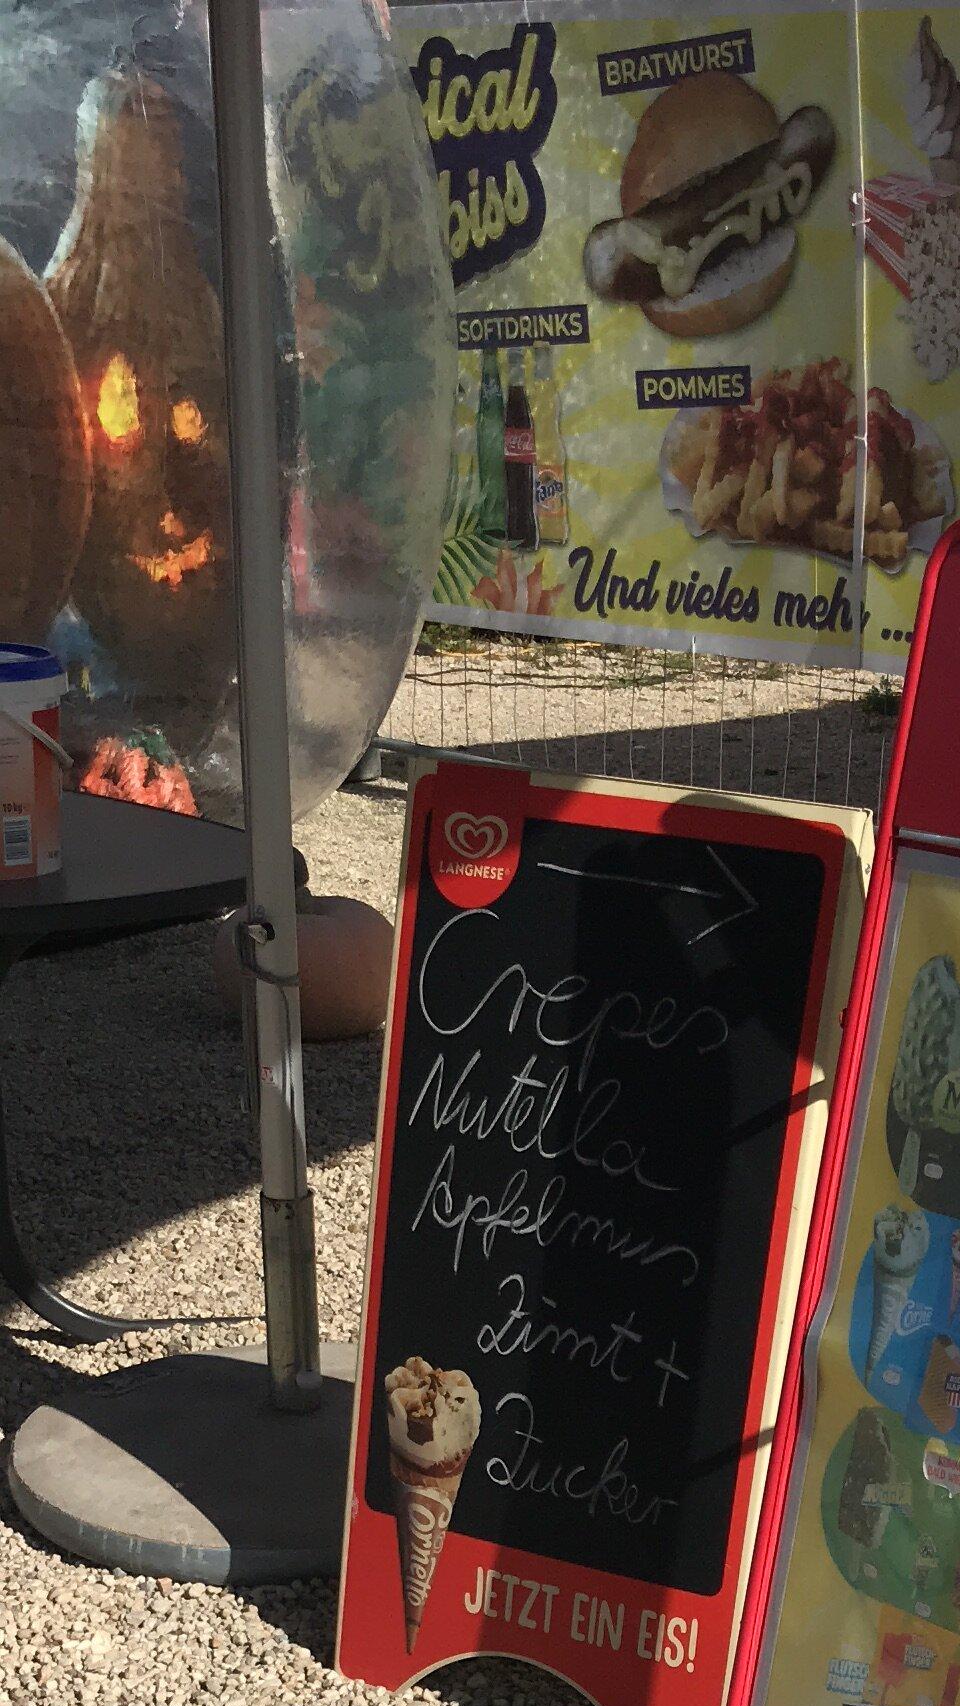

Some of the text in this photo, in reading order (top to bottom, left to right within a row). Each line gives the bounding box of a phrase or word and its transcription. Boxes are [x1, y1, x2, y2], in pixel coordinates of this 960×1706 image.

[423, 33, 540, 141] ical
[605, 38, 746, 87] BRATWURST
[459, 312, 583, 343] SOFTDRINKS
[642, 373, 746, 403] POMMES
[568, 546, 660, 618] Und
[666, 567, 759, 622] vieles
[420, 909, 728, 1091] Crepes
[409, 1050, 681, 1190] Nutella
[412, 1144, 700, 1288] Apfelmus
[486, 1392, 678, 1524] Zucker
[406, 1486, 453, 1607] Cornetto
[464, 1566, 698, 1673] JETZT EIN EIS!
